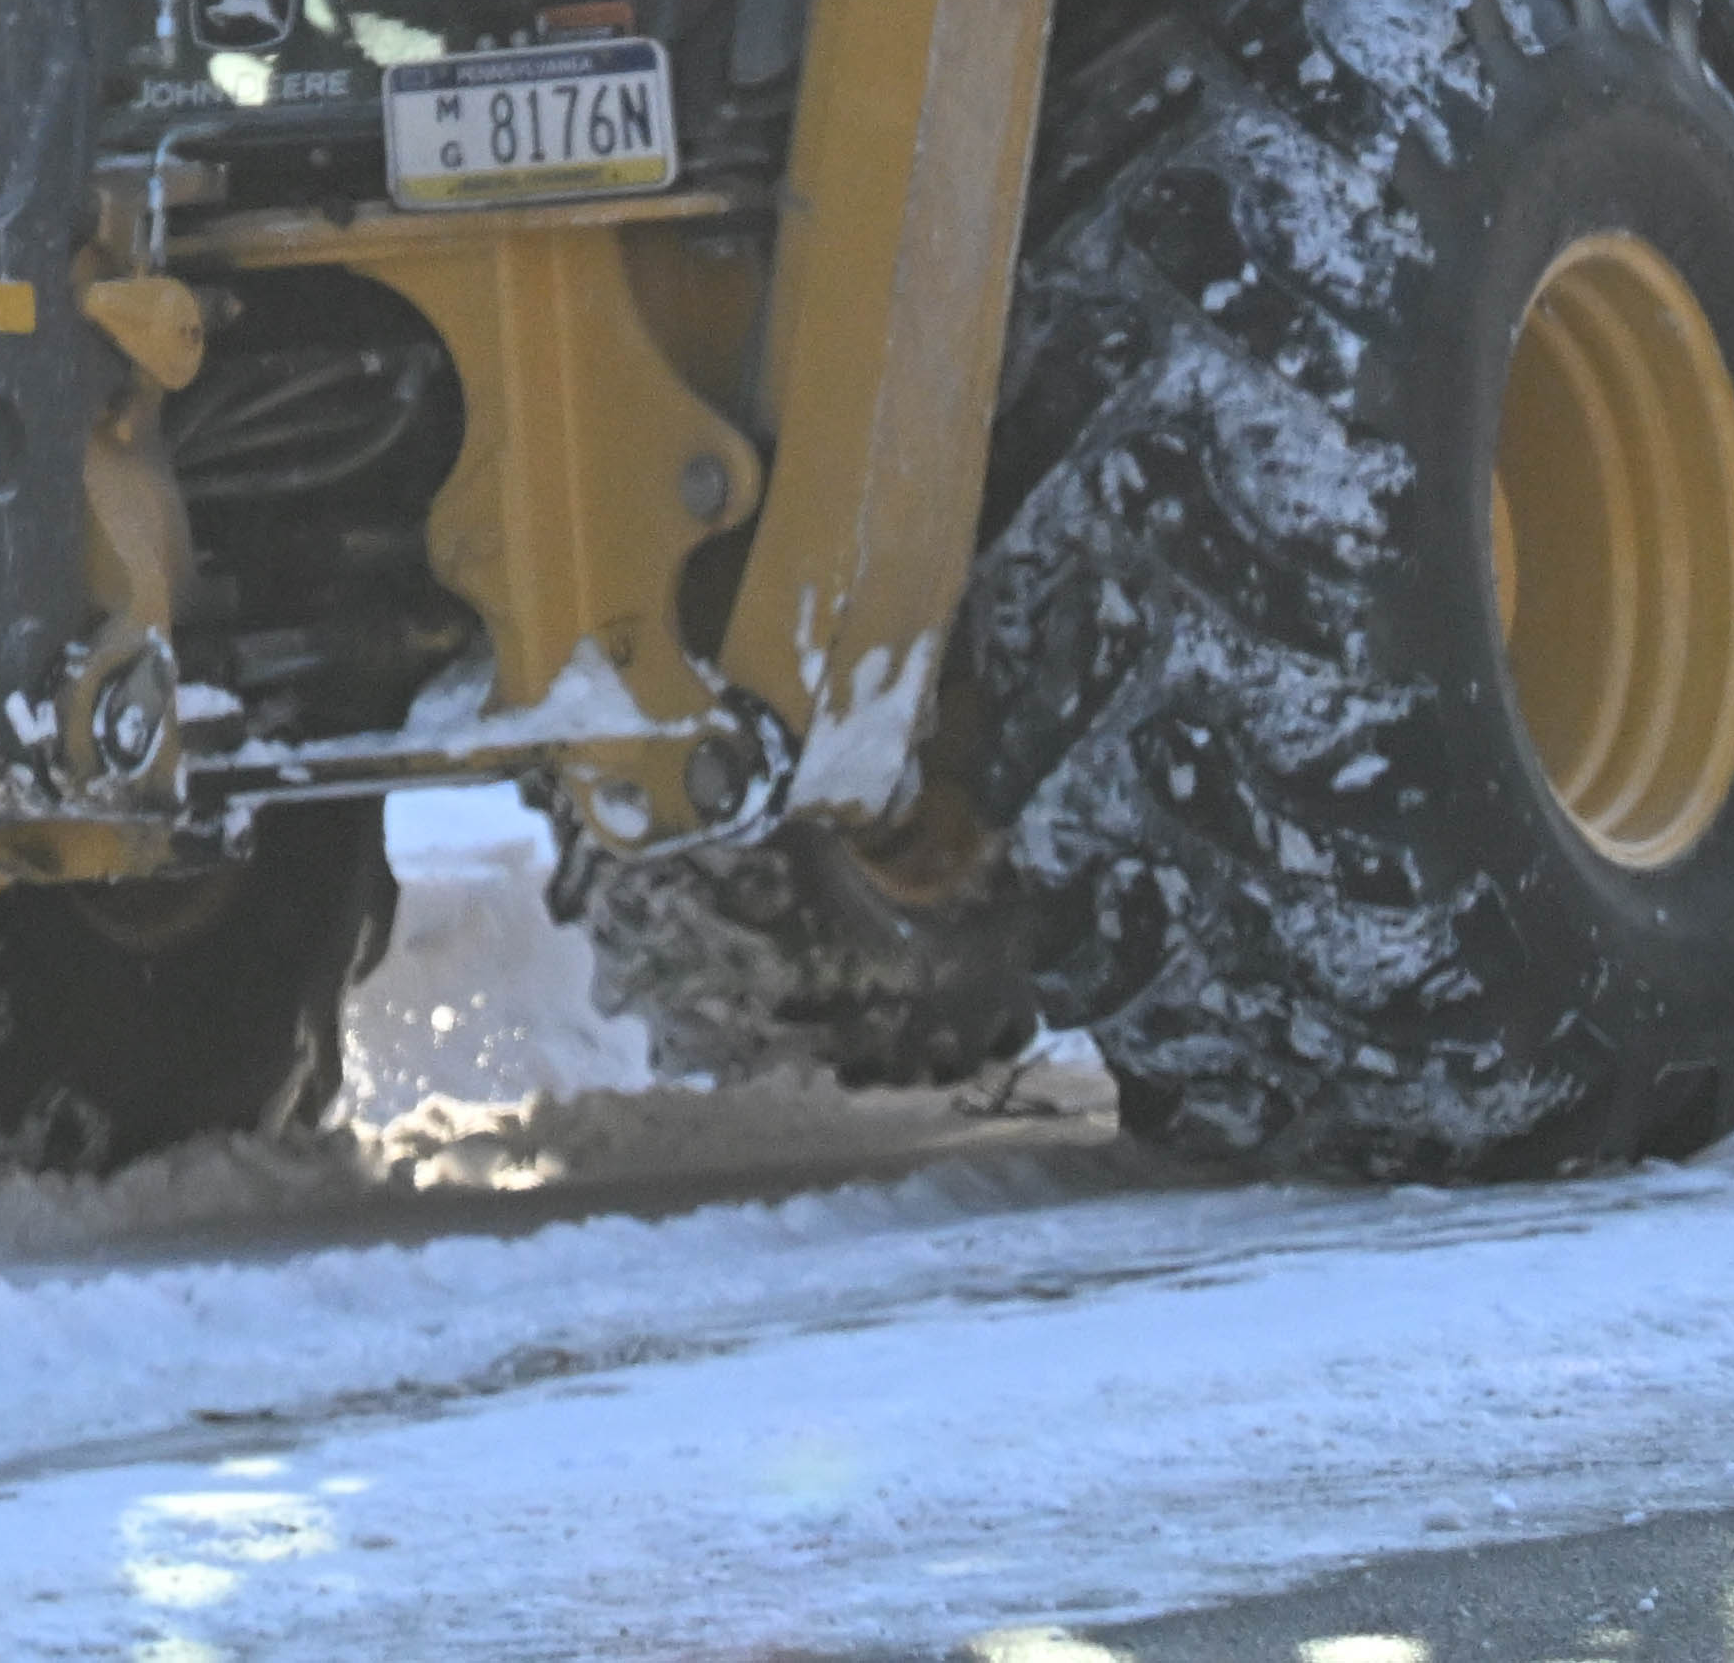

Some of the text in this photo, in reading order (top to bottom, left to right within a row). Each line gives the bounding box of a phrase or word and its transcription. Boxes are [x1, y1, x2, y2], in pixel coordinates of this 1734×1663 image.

[435, 94, 461, 122] M
[488, 82, 653, 165] 8176N
[439, 139, 464, 168] G
